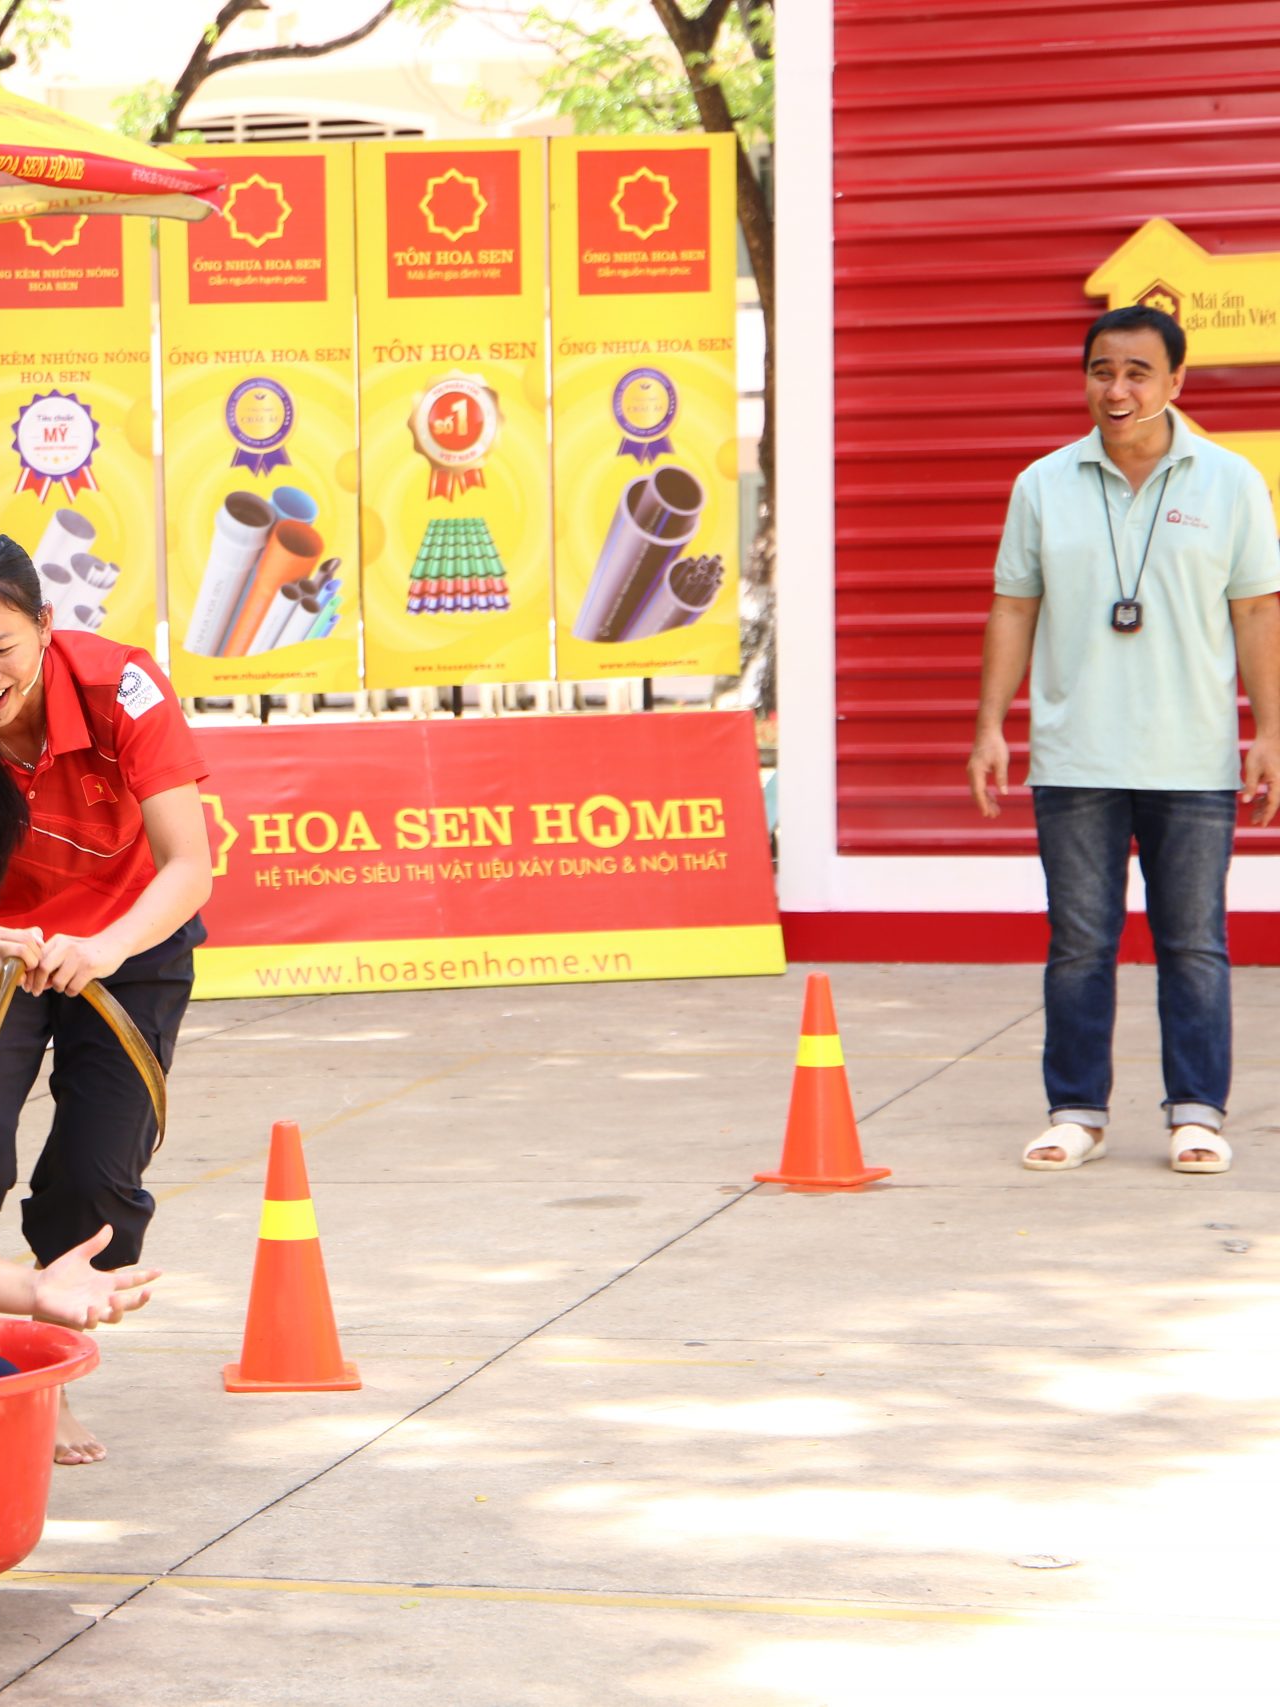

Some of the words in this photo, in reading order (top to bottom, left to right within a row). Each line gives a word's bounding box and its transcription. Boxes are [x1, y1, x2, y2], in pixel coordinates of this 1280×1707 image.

[18, 156, 45, 178] SEN
[48, 155, 85, 181] HOME
[192, 257, 222, 272] ỐNG
[265, 258, 292, 271] HOA
[295, 258, 322, 270] SEN
[394, 246, 431, 266] TÔN
[435, 251, 474, 265] HOA
[478, 249, 513, 264] SEN
[651, 250, 678, 262] HOA
[680, 249, 705, 262] SEN
[28, 281, 54, 292] HOA
[55, 281, 78, 291] SEN
[1191, 291, 1217, 311] Mái
[1221, 289, 1245, 309] ấm
[1185, 310, 1207, 331] gia
[1211, 309, 1245, 329] đình
[1248, 307, 1277, 328] Việt
[169, 345, 208, 365] ỐNG
[213, 349, 265, 367] NHỰA
[271, 348, 310, 363] HOA
[314, 347, 351, 362] SEN
[373, 338, 423, 363] TÔN
[431, 344, 481, 361] HOA
[489, 342, 537, 360] SEN
[655, 338, 694, 353] HOA
[697, 337, 734, 352] SEN
[41, 349, 99, 365] NHÚNG
[104, 348, 150, 364] NÓNG
[21, 371, 55, 384] HOA
[59, 370, 91, 383] SEN
[451, 398, 468, 436] 1
[43, 423, 68, 443] MỸ
[247, 809, 382, 856] HOA
[394, 804, 515, 851] SEN
[531, 794, 726, 849] HOME
[255, 865, 282, 890] HỆ
[285, 862, 357, 887] THỐNG
[361, 861, 401, 884] SIÊU
[405, 863, 435, 885] THỊ
[438, 859, 473, 884] VẬT
[479, 857, 514, 883] LIỆU
[518, 855, 554, 878] XÂY
[559, 855, 618, 879] DỰNG
[622, 855, 636, 875] &
[640, 851, 678, 876] NỘI
[682, 848, 728, 872] THẤT
[255, 947, 633, 988] www.hoasenhome.vn
